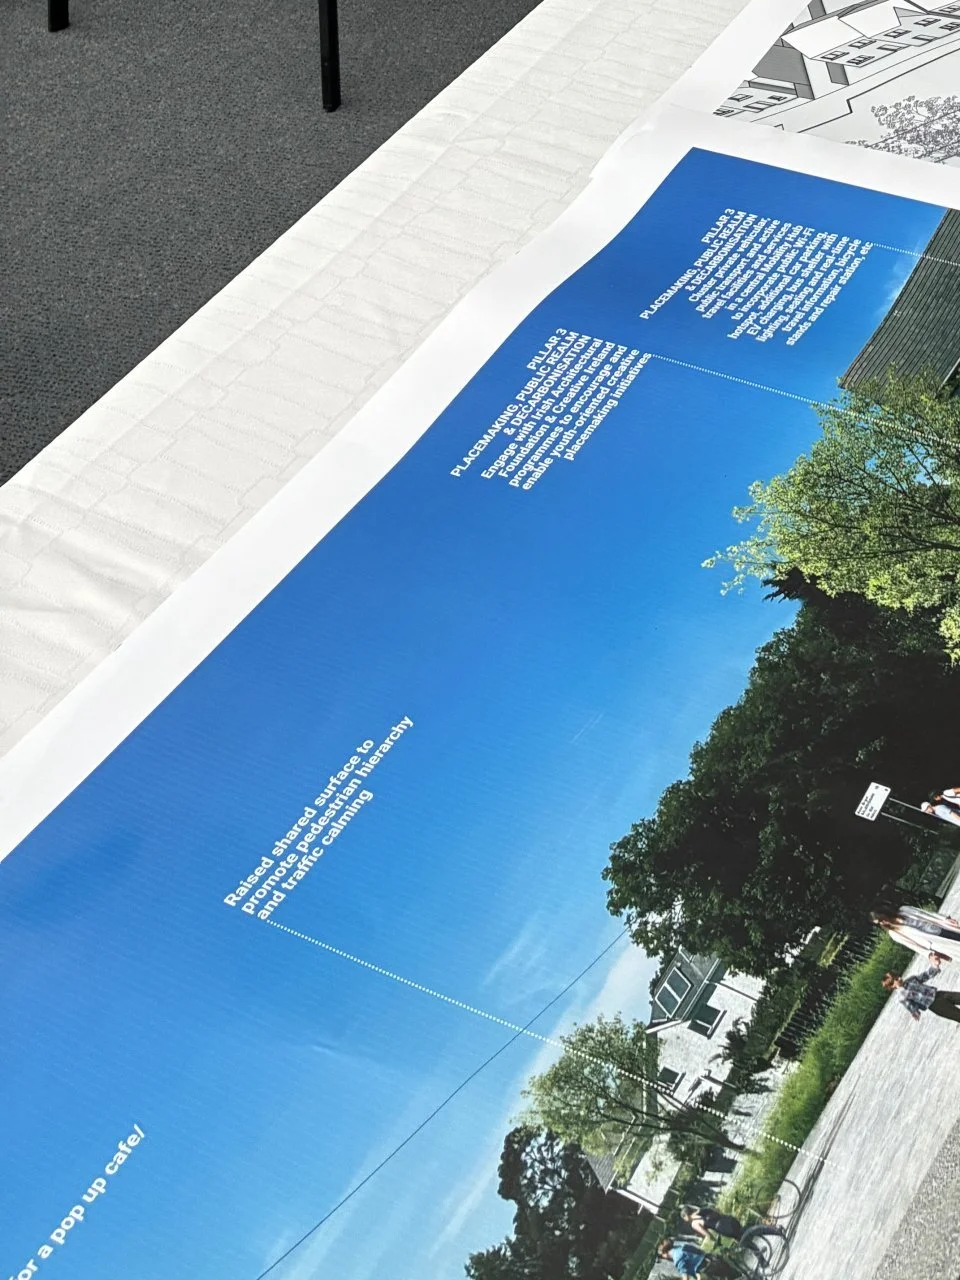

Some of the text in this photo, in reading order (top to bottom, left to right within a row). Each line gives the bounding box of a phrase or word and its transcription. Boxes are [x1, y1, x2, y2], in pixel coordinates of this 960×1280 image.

[639, 210, 747, 320] PLACEMAKING, PUBLIC REALM
[688, 277, 718, 302] Cluster
[714, 252, 741, 279] private
[690, 213, 758, 285] DECARBONISATION
[695, 219, 781, 313] public transport and active
[700, 214, 731, 244] PILLAR
[701, 222, 792, 319] travel facilities and services
[724, 302, 739, 311] in
[740, 271, 767, 298] central
[759, 241, 793, 273] Mobility
[784, 225, 804, 242] Hub
[730, 227, 815, 321] to incorporate public Wi-Fi
[779, 286, 814, 314] seating
[807, 270, 825, 287] and
[819, 236, 850, 272] real-time
[727, 311, 763, 340] hotspot,
[757, 274, 793, 311] additional
[788, 262, 803, 276] car
[746, 323, 762, 336] EV
[785, 277, 805, 293] bus
[800, 250, 825, 278] shelter
[820, 233, 839, 251] with
[781, 239, 862, 332] travel information, bicycle
[785, 241, 874, 346] stands and repair station, etc
[503, 334, 592, 436] & DECARBONISATION
[526, 328, 567, 370] PILLAR 3
[450, 331, 580, 477] PLACEMAKING, PUBLIC REALM
[480, 337, 604, 479] Engage with Irish Architectural
[497, 341, 616, 478] Foundation & Creative Ireland
[508, 344, 628, 488] programmes to encourage and
[522, 349, 640, 490] enable youth-oriented creative
[563, 352, 652, 461] placemaking initiatives
[223, 739, 374, 907] Raised shared surface to
[241, 716, 414, 915] promote pedestrian hierarchy
[257, 789, 374, 920] and traffic calming
[9, 1258, 38, 1280] or
[37, 1244, 54, 1259] a
[49, 1204, 85, 1245] pop
[82, 1177, 107, 1203] up
